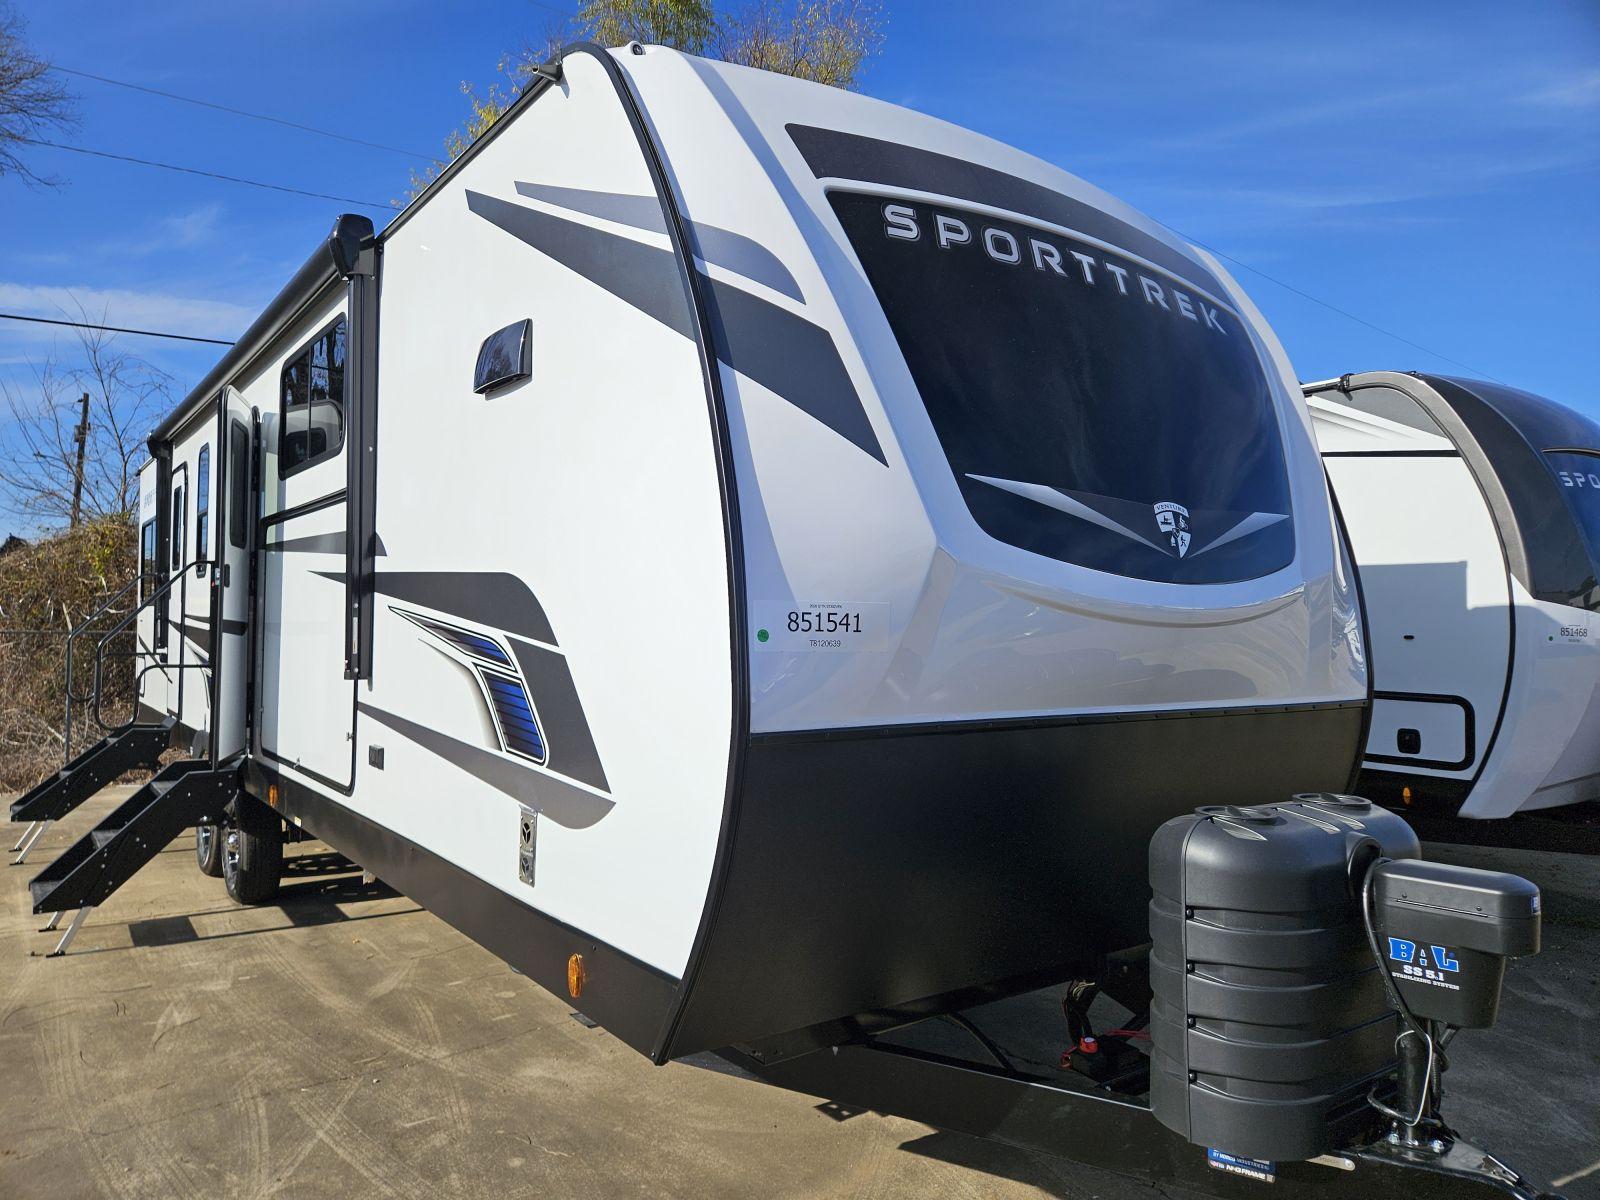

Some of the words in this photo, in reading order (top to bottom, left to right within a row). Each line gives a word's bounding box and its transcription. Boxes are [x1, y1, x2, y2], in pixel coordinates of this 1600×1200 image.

[882, 204, 1227, 335] SPORTTREK
[787, 611, 862, 633] 851541
[1560, 626, 1588, 637] 851468
[1403, 964, 1423, 976] SS
[1432, 980, 1459, 990] SYSTEM
